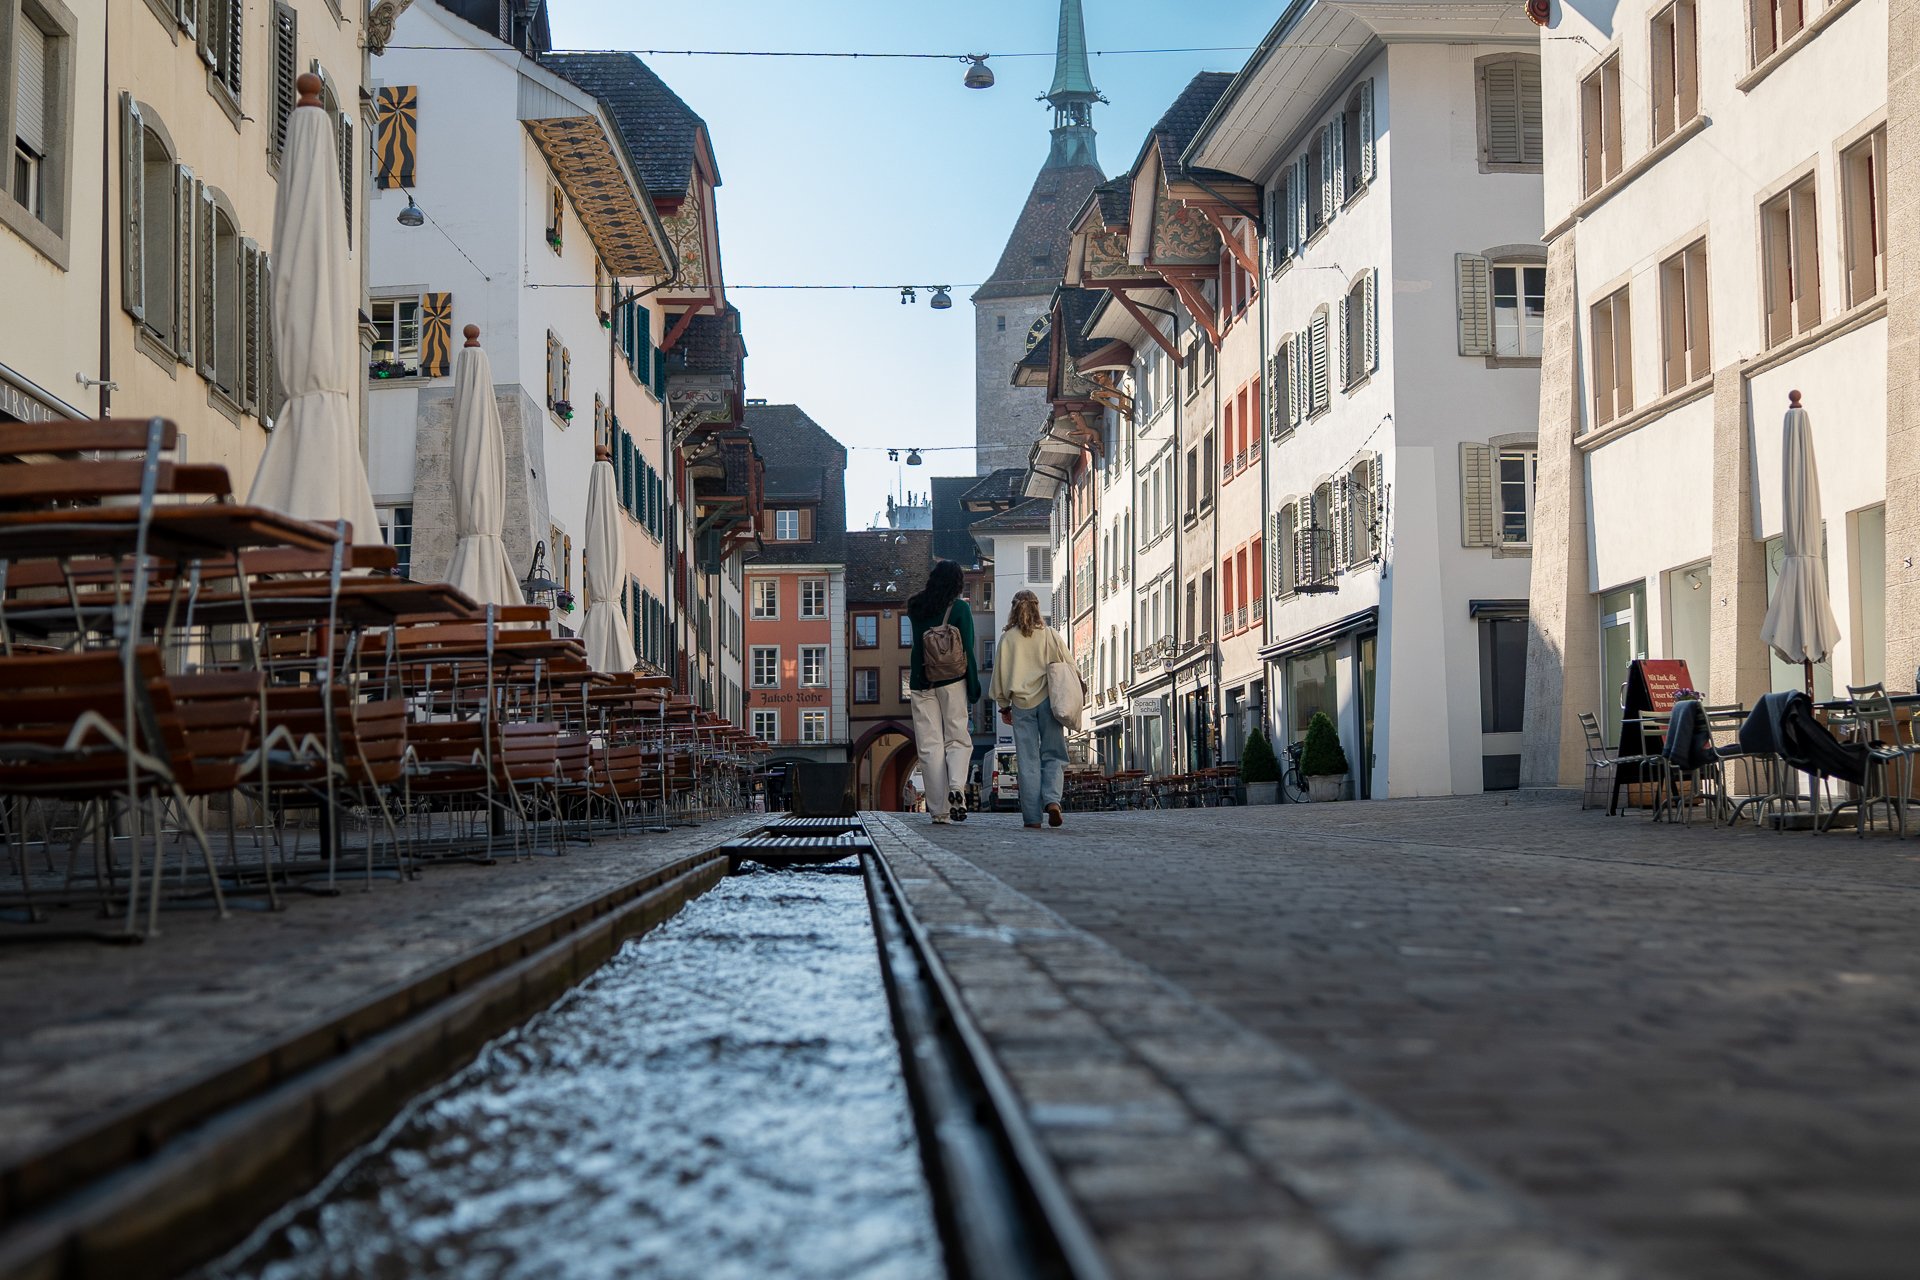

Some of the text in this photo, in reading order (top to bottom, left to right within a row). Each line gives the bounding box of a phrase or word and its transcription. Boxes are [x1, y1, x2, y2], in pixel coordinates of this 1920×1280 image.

[760, 692, 823, 705] Jakob Rohr
[1134, 700, 1157, 708] Sprach
